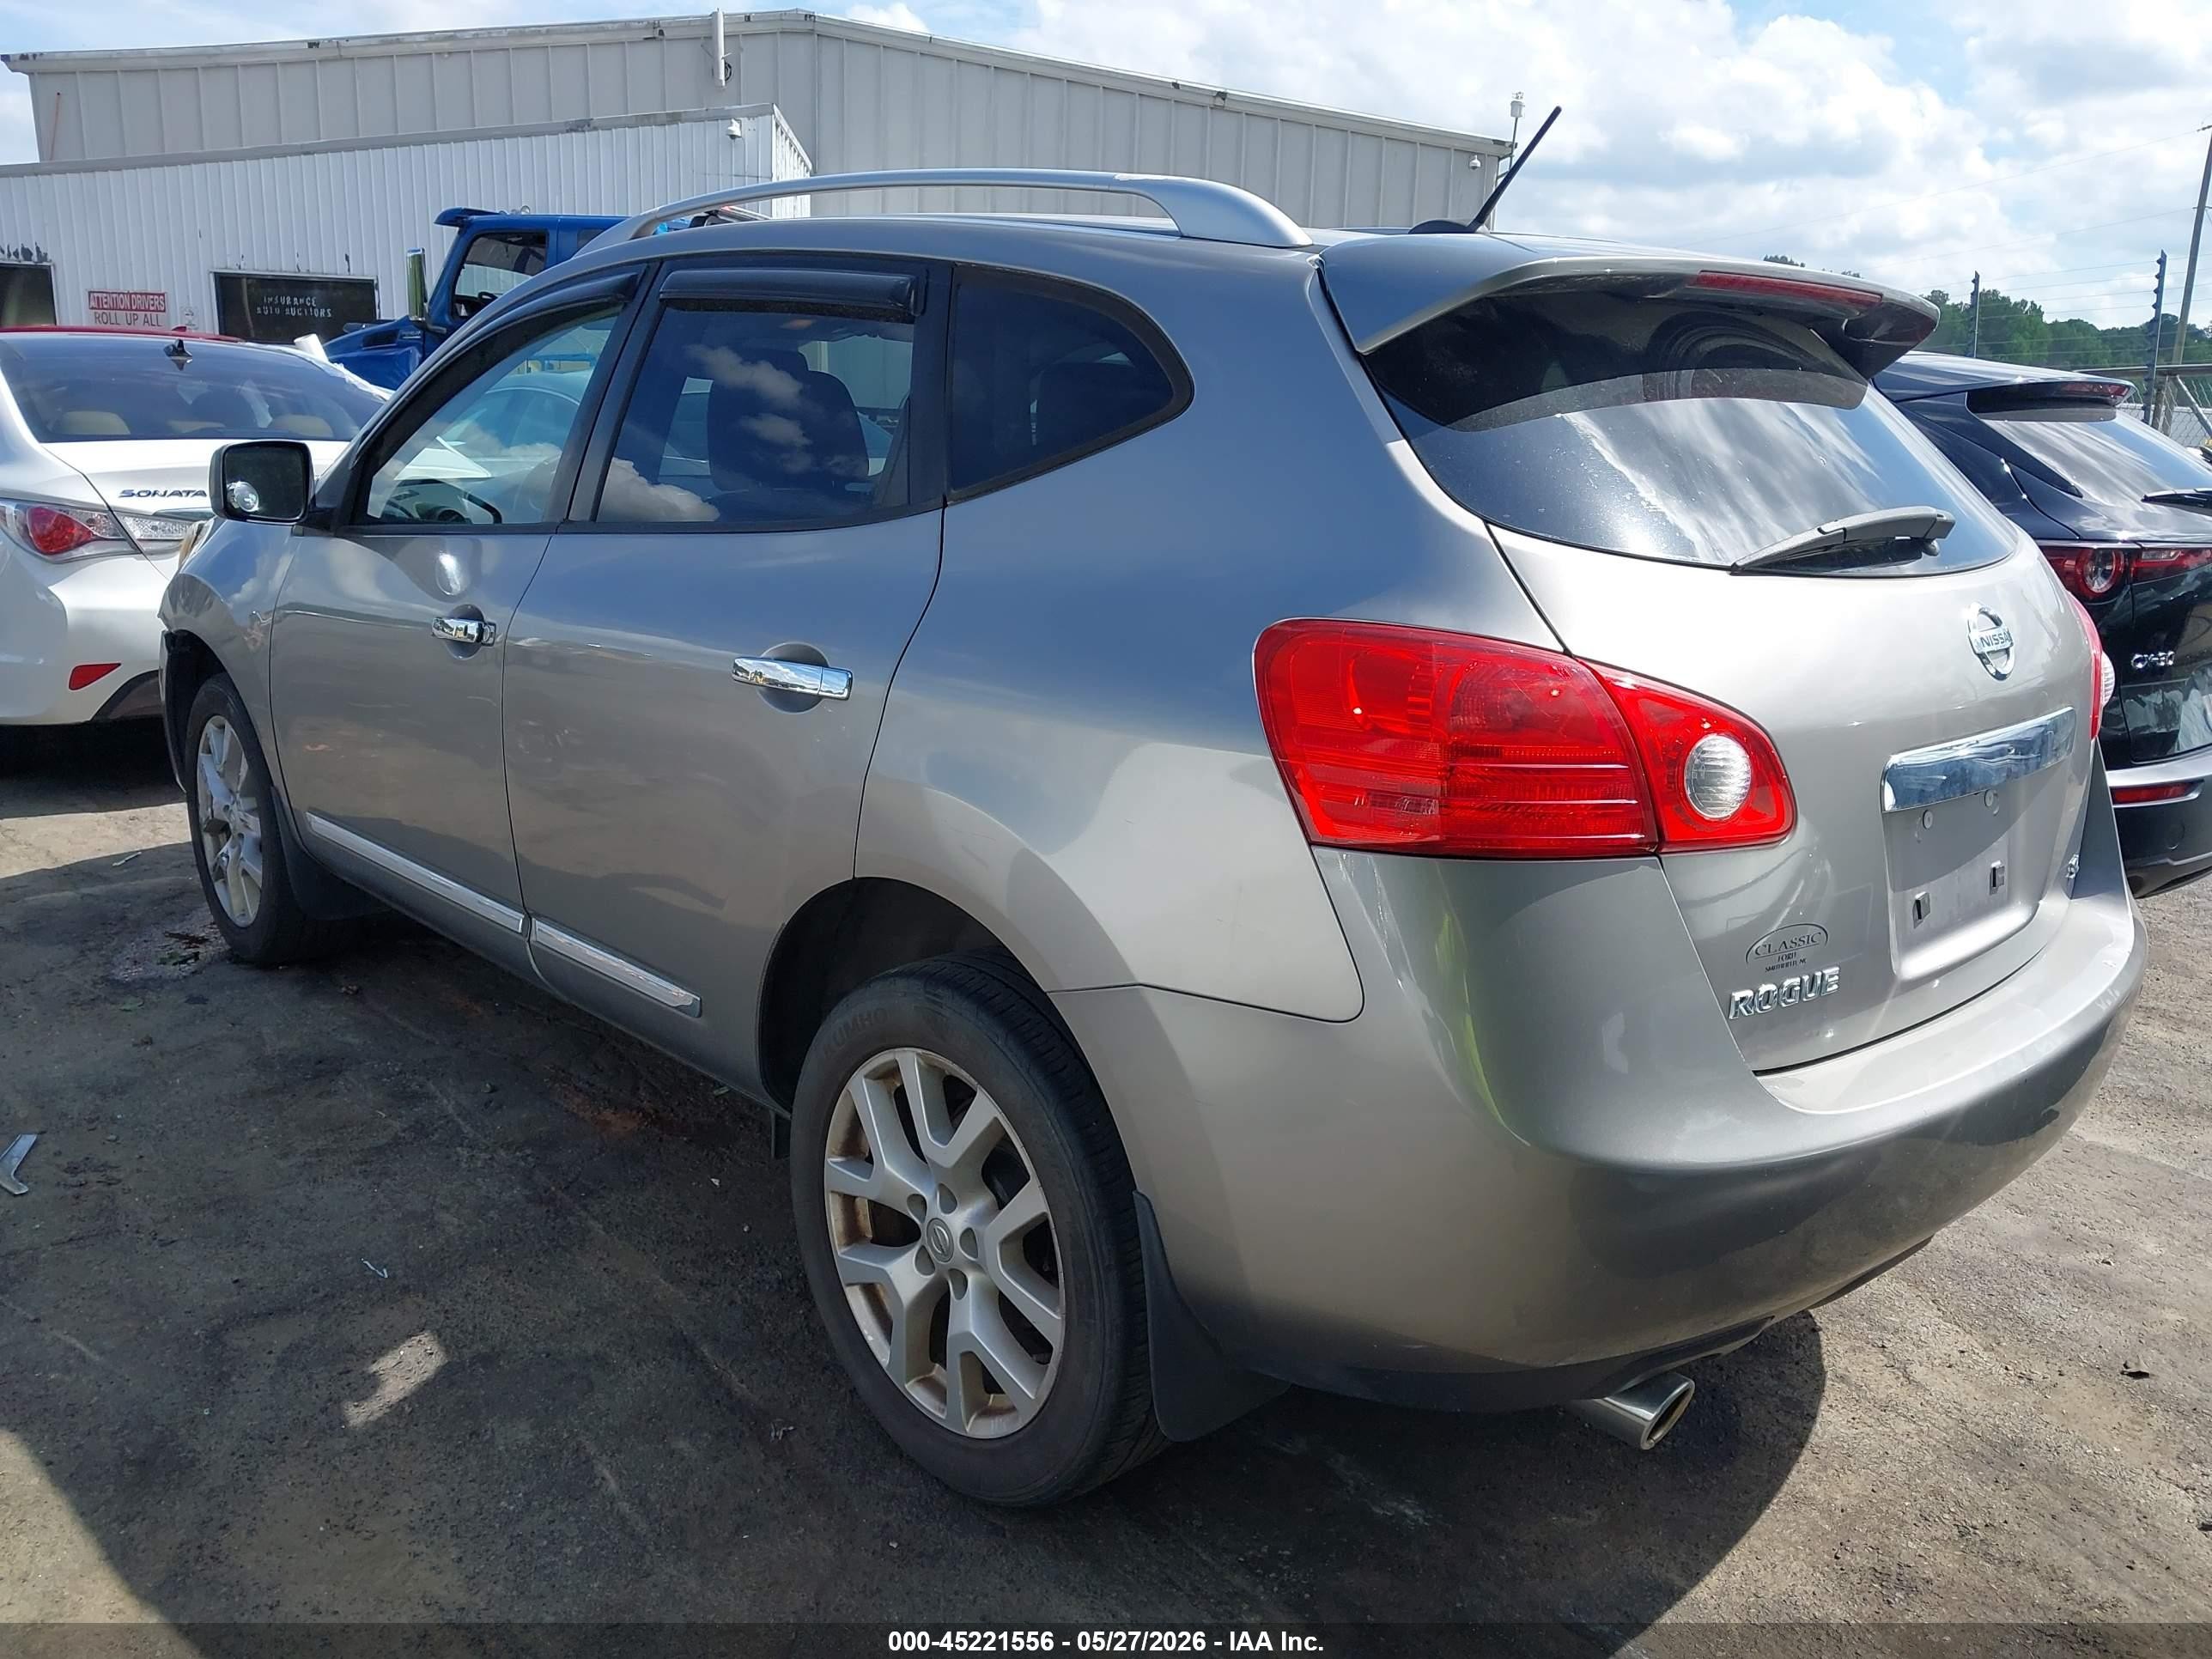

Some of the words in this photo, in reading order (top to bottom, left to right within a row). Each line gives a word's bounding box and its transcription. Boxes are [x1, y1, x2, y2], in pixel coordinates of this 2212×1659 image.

[89, 292, 130, 309] ATTENTION
[131, 294, 165, 311] DRIVERS
[264, 295, 317, 307] INSURANCE
[94, 311, 121, 325] ROLL
[125, 313, 139, 325] UP
[143, 313, 163, 326] ALL
[118, 489, 208, 498] SONATA
[1754, 932, 1822, 957] CLASSIC
[1729, 966, 1841, 1020] ROGUE
